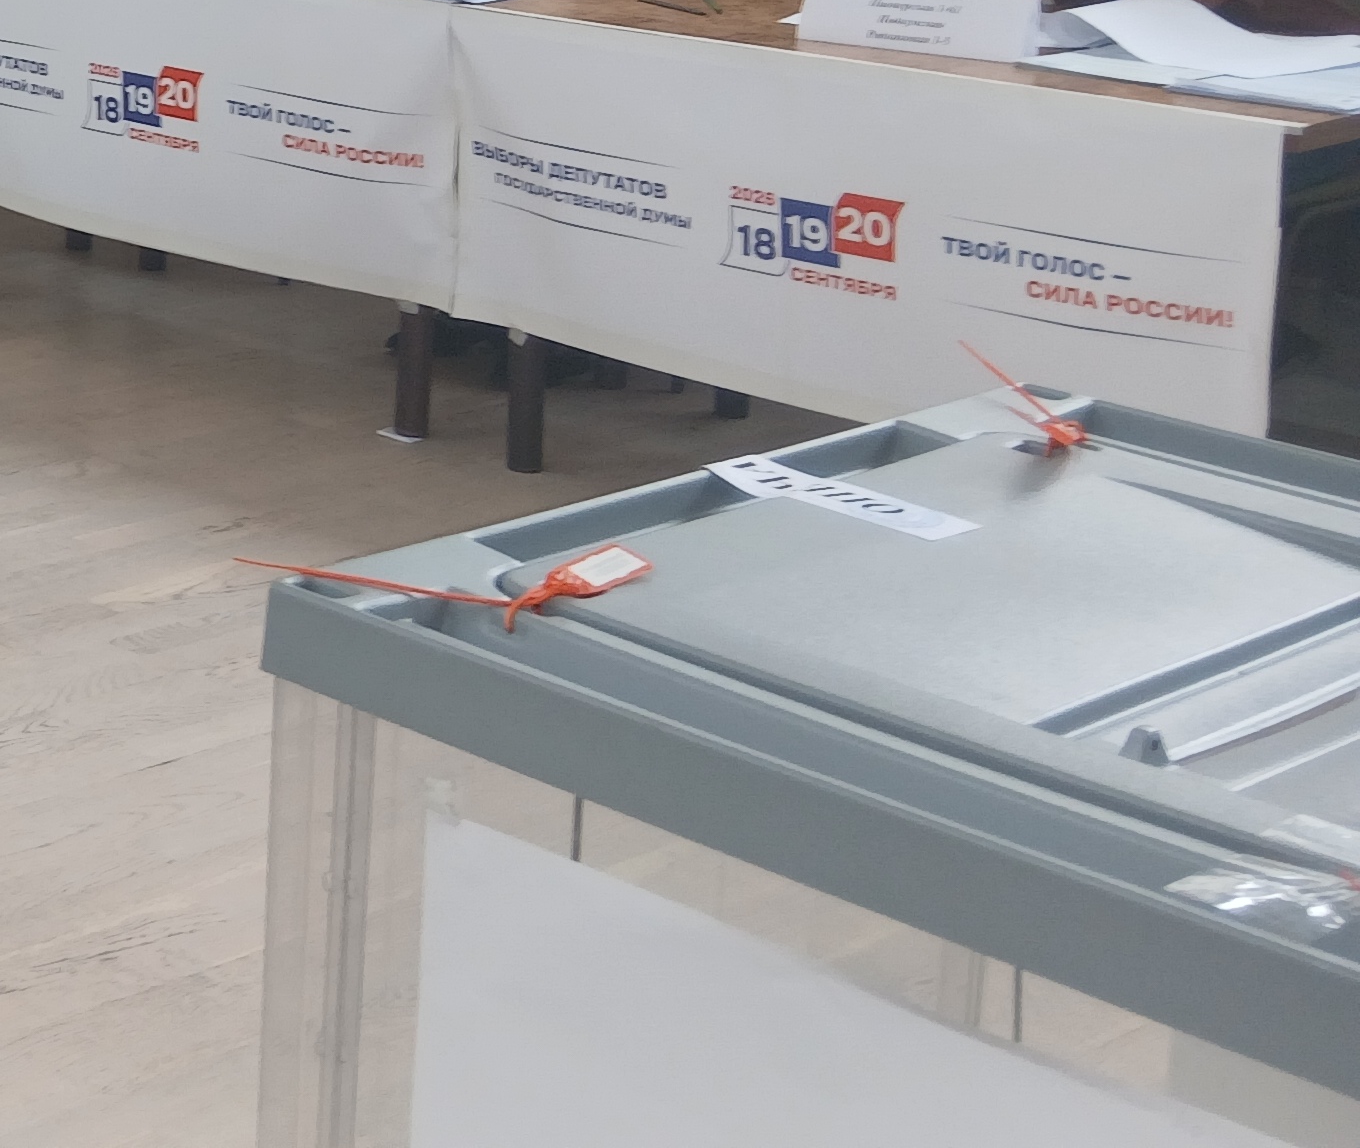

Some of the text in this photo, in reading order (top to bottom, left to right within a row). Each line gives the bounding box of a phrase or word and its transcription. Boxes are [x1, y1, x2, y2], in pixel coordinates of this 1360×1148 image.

[93, 77, 195, 124] 18 19 20
[226, 98, 273, 122] ТВОЙ
[276, 109, 335, 134] ГОЛОС
[128, 127, 200, 153] СЕНТЯБРЯ
[282, 134, 425, 168] СИЛА РОССИИ!
[470, 140, 667, 199] ВЫБОРЫ ДЕПУТАТОВ
[493, 172, 692, 230] ГОСУДАРСТВЕННОЙ ДУМЫ
[736, 206, 891, 260] 18 19 20
[940, 236, 1011, 264] ТВОЙ
[1015, 250, 1105, 281] ГОЛОС
[789, 266, 898, 301] СЕНТЯБРЯ
[1025, 280, 1235, 328] СИЛА РОССИИ!
